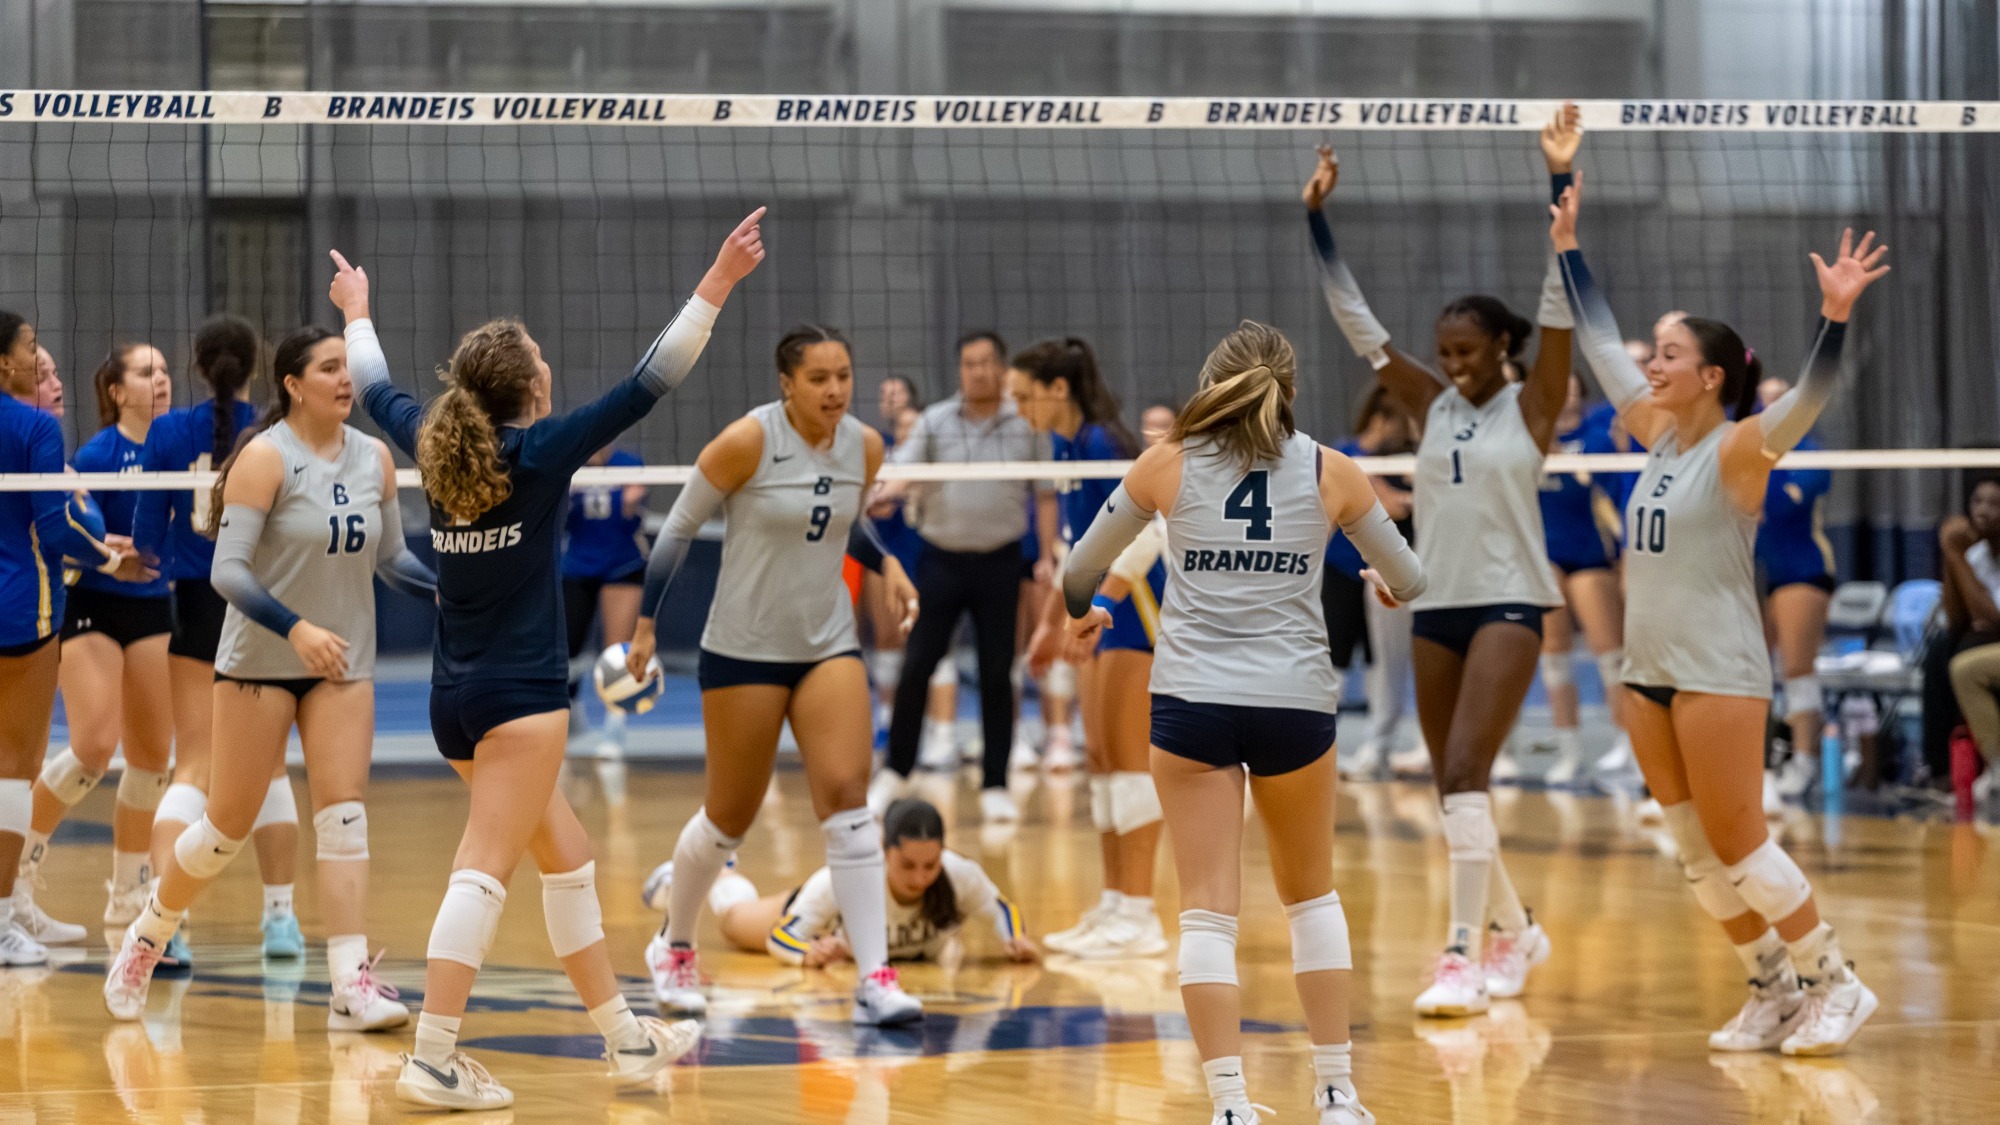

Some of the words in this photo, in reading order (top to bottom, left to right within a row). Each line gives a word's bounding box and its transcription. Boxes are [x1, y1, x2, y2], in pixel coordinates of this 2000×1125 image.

[35, 93, 215, 118] VOLLEYBALL
[262, 96, 282, 118] B
[327, 96, 474, 119] BRANDEIS
[494, 97, 666, 120] VOLLEYBALL
[713, 100, 732, 120] B
[776, 99, 917, 121] BRANDEIS
[935, 101, 1103, 122] VOLLEYBALL
[1147, 102, 1164, 122] B
[1206, 102, 1342, 123] BRANDEIS
[1359, 103, 1519, 124] VOLLEYBALL
[1621, 104, 1749, 125] BRANDEIS
[1766, 105, 1918, 126] VOLLEYBALL
[1960, 105, 1977, 126] B
[1452, 449, 1463, 484] 1
[333, 482, 350, 506] B
[1223, 469, 1273, 541] 4
[326, 513, 367, 556] 16
[806, 505, 831, 542] 9
[1635, 506, 1665, 553] 10
[1184, 549, 1310, 576] BRANDEIS
